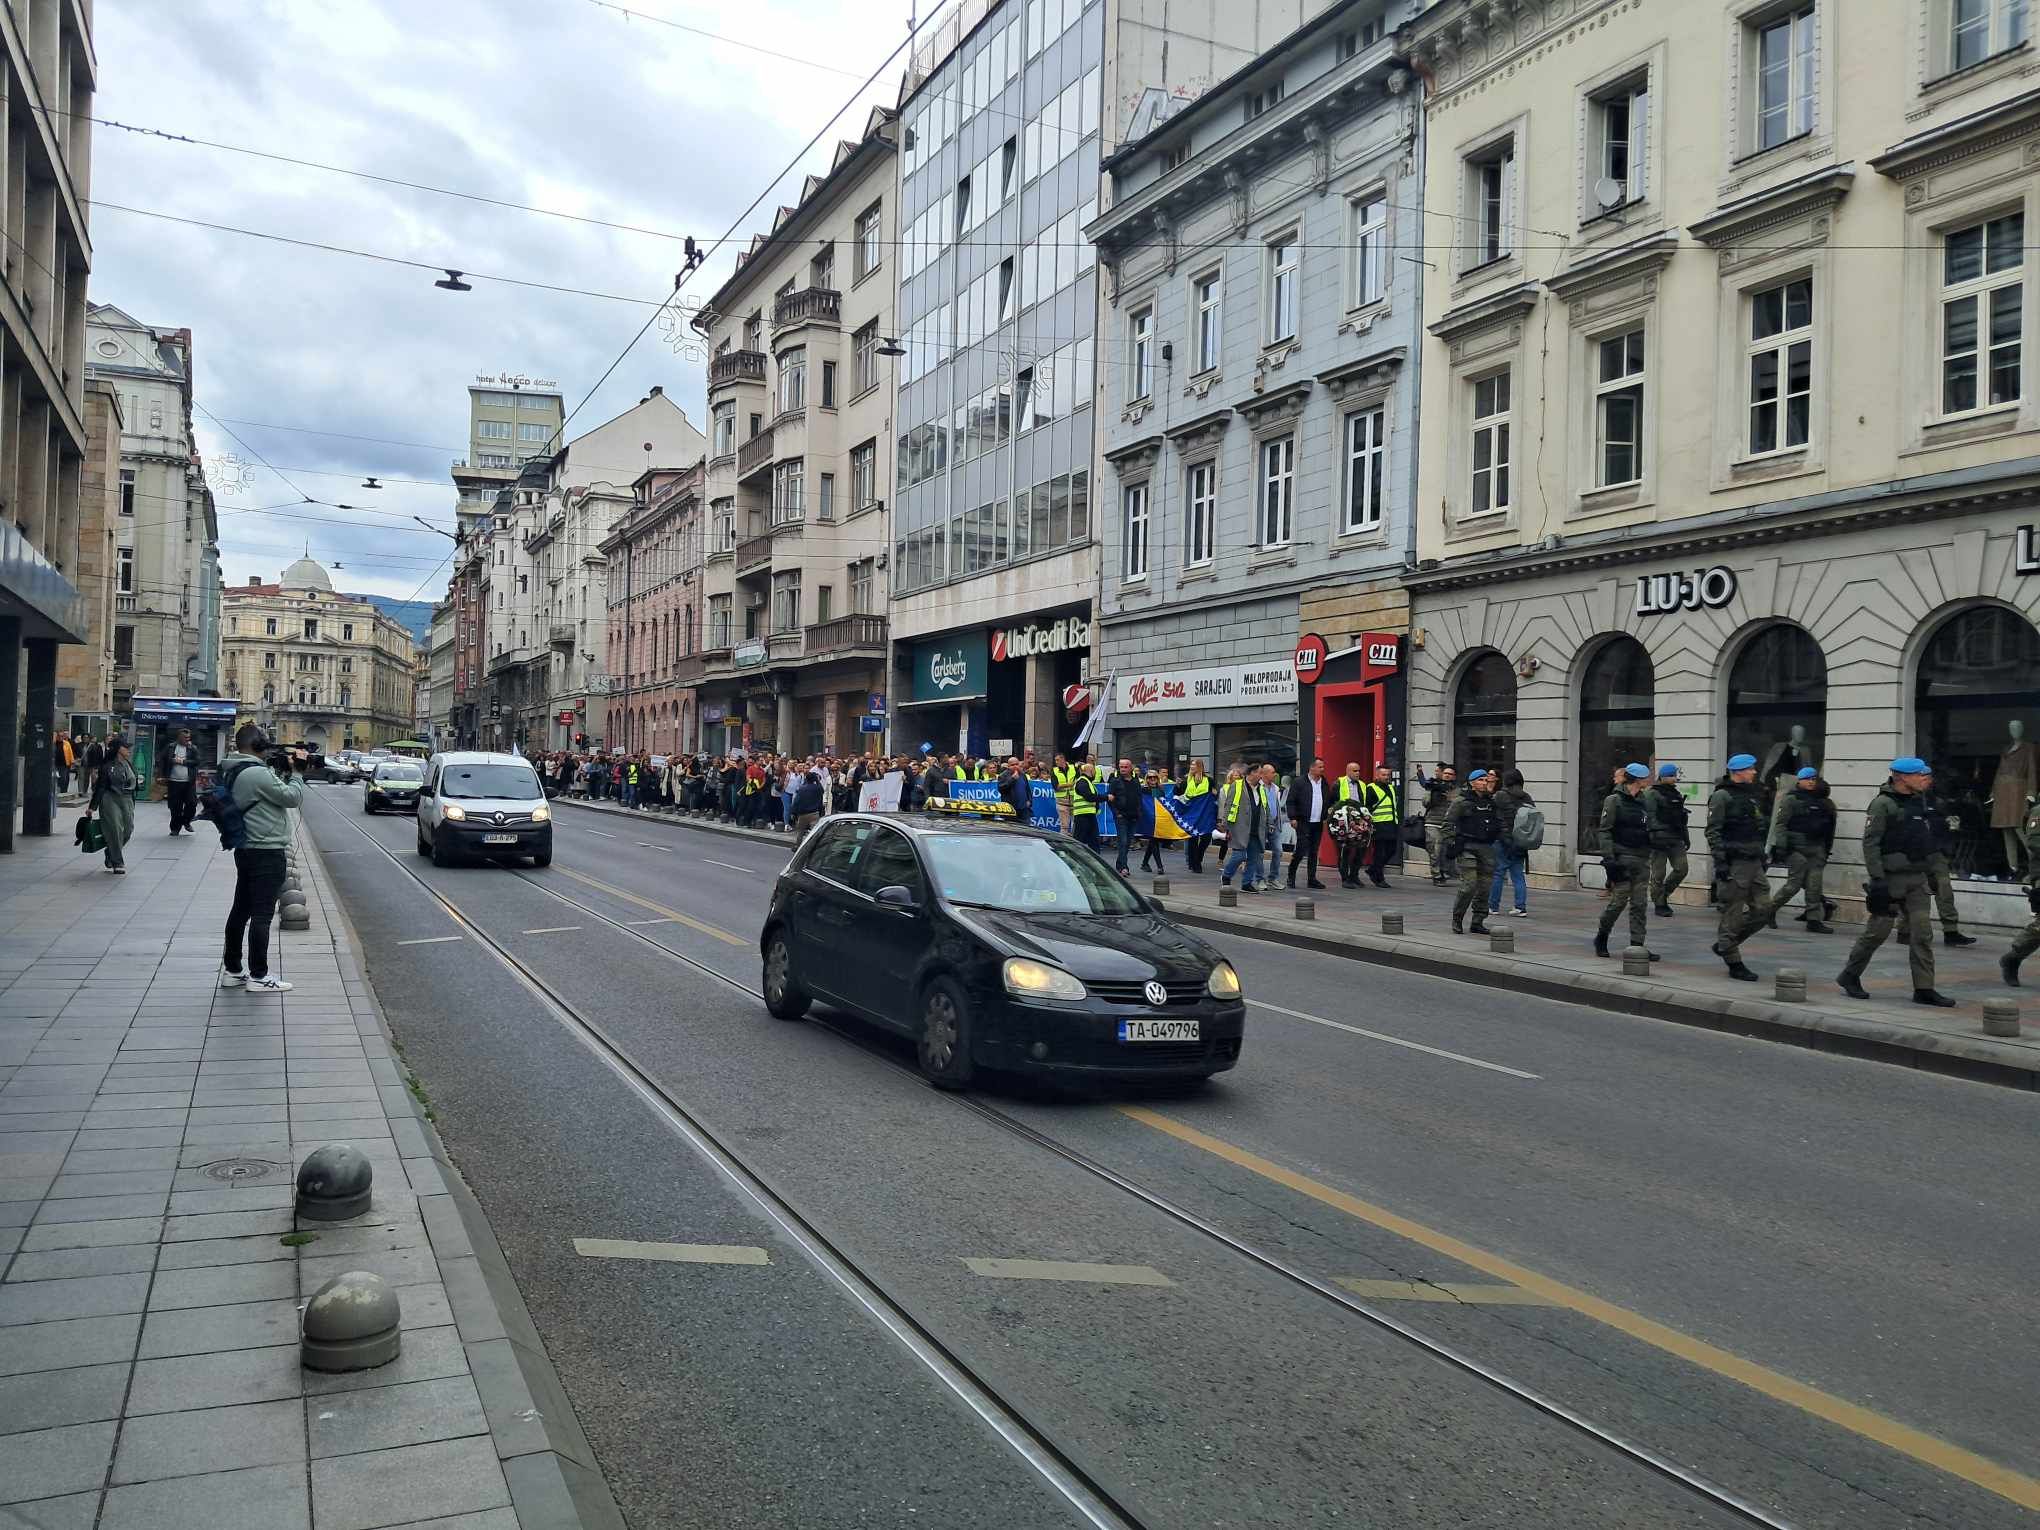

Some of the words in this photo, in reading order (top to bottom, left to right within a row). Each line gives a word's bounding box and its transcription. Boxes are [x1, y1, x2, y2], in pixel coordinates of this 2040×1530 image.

[1007, 620, 1068, 659] UniCredit
[1296, 648, 1317, 665] cm
[1369, 643, 1397, 660] cm
[931, 652, 967, 685] Carlsberg
[1243, 670, 1292, 685] MALOPRODAJA
[1194, 678, 1232, 697] SARAJEVO
[1240, 683, 1279, 696] PRODAVNICA
[950, 801, 996, 812] TAXI
[1127, 1022, 1199, 1038] TA-049796
